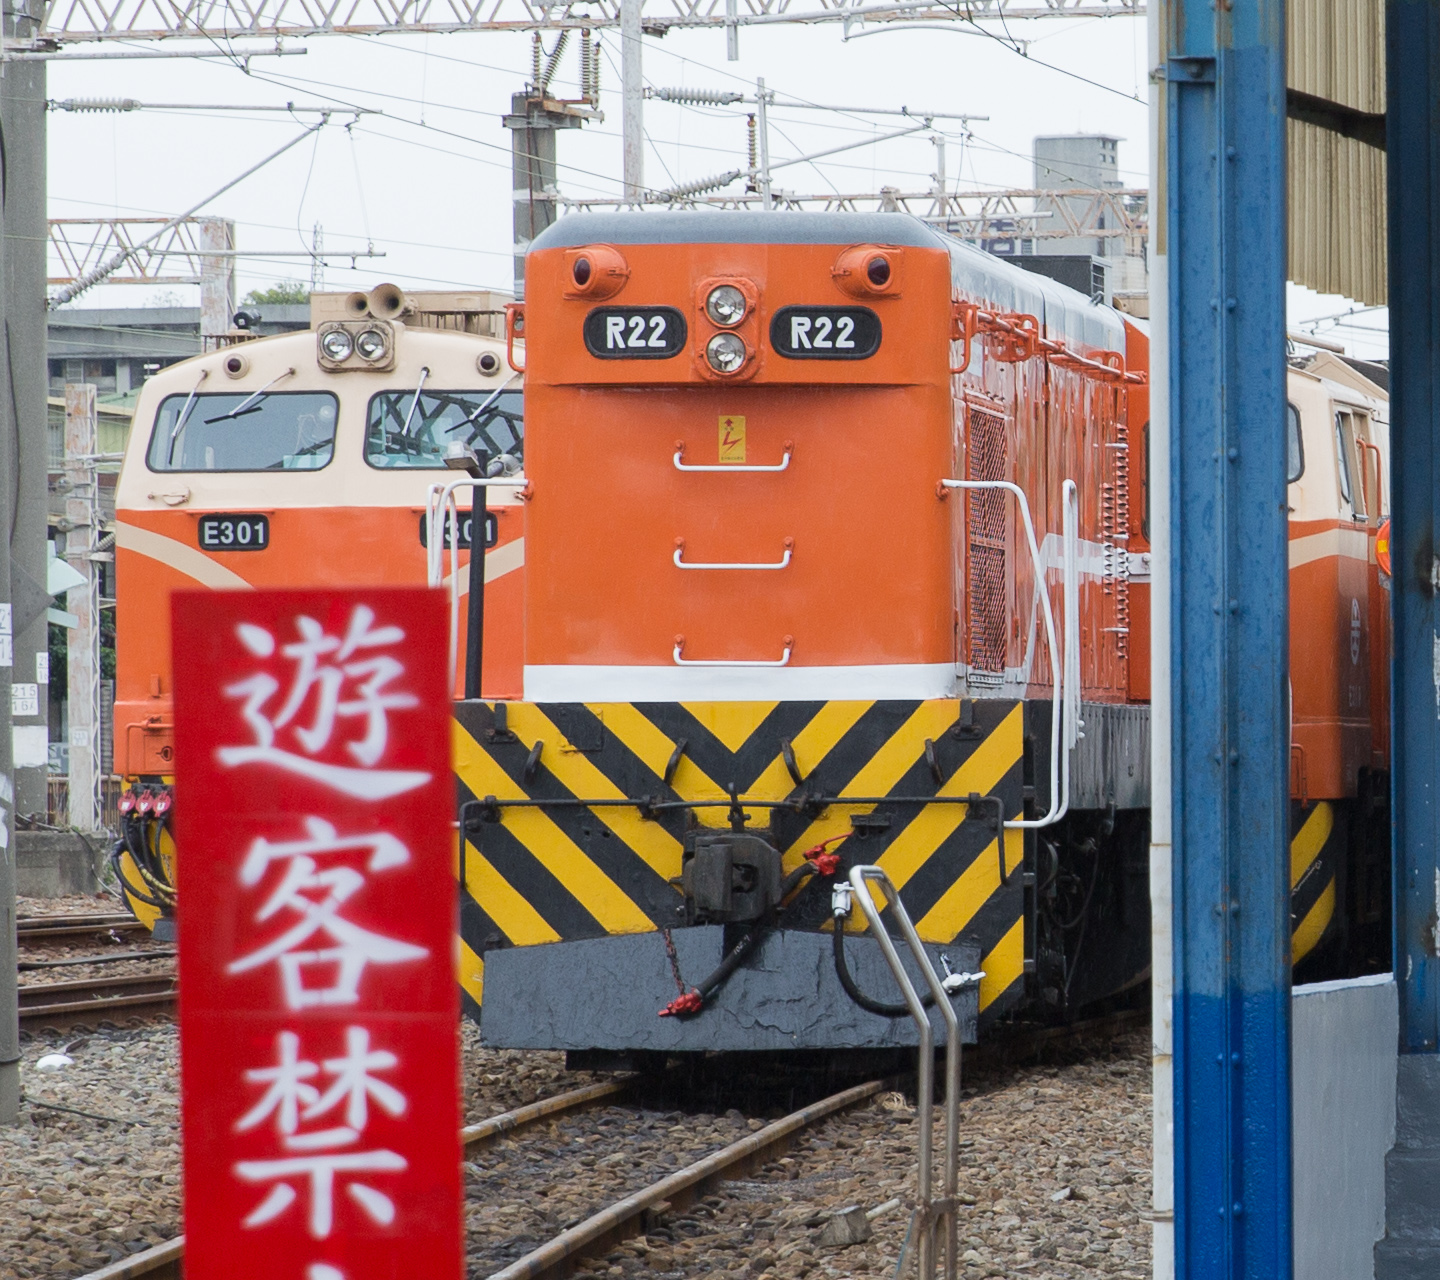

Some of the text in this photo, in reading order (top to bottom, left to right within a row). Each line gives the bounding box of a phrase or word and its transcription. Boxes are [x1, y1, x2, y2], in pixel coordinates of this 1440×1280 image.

[606, 316, 667, 348] R22
[790, 316, 855, 348] R22
[204, 521, 264, 544] E301
[11, 685, 36, 697] 215
